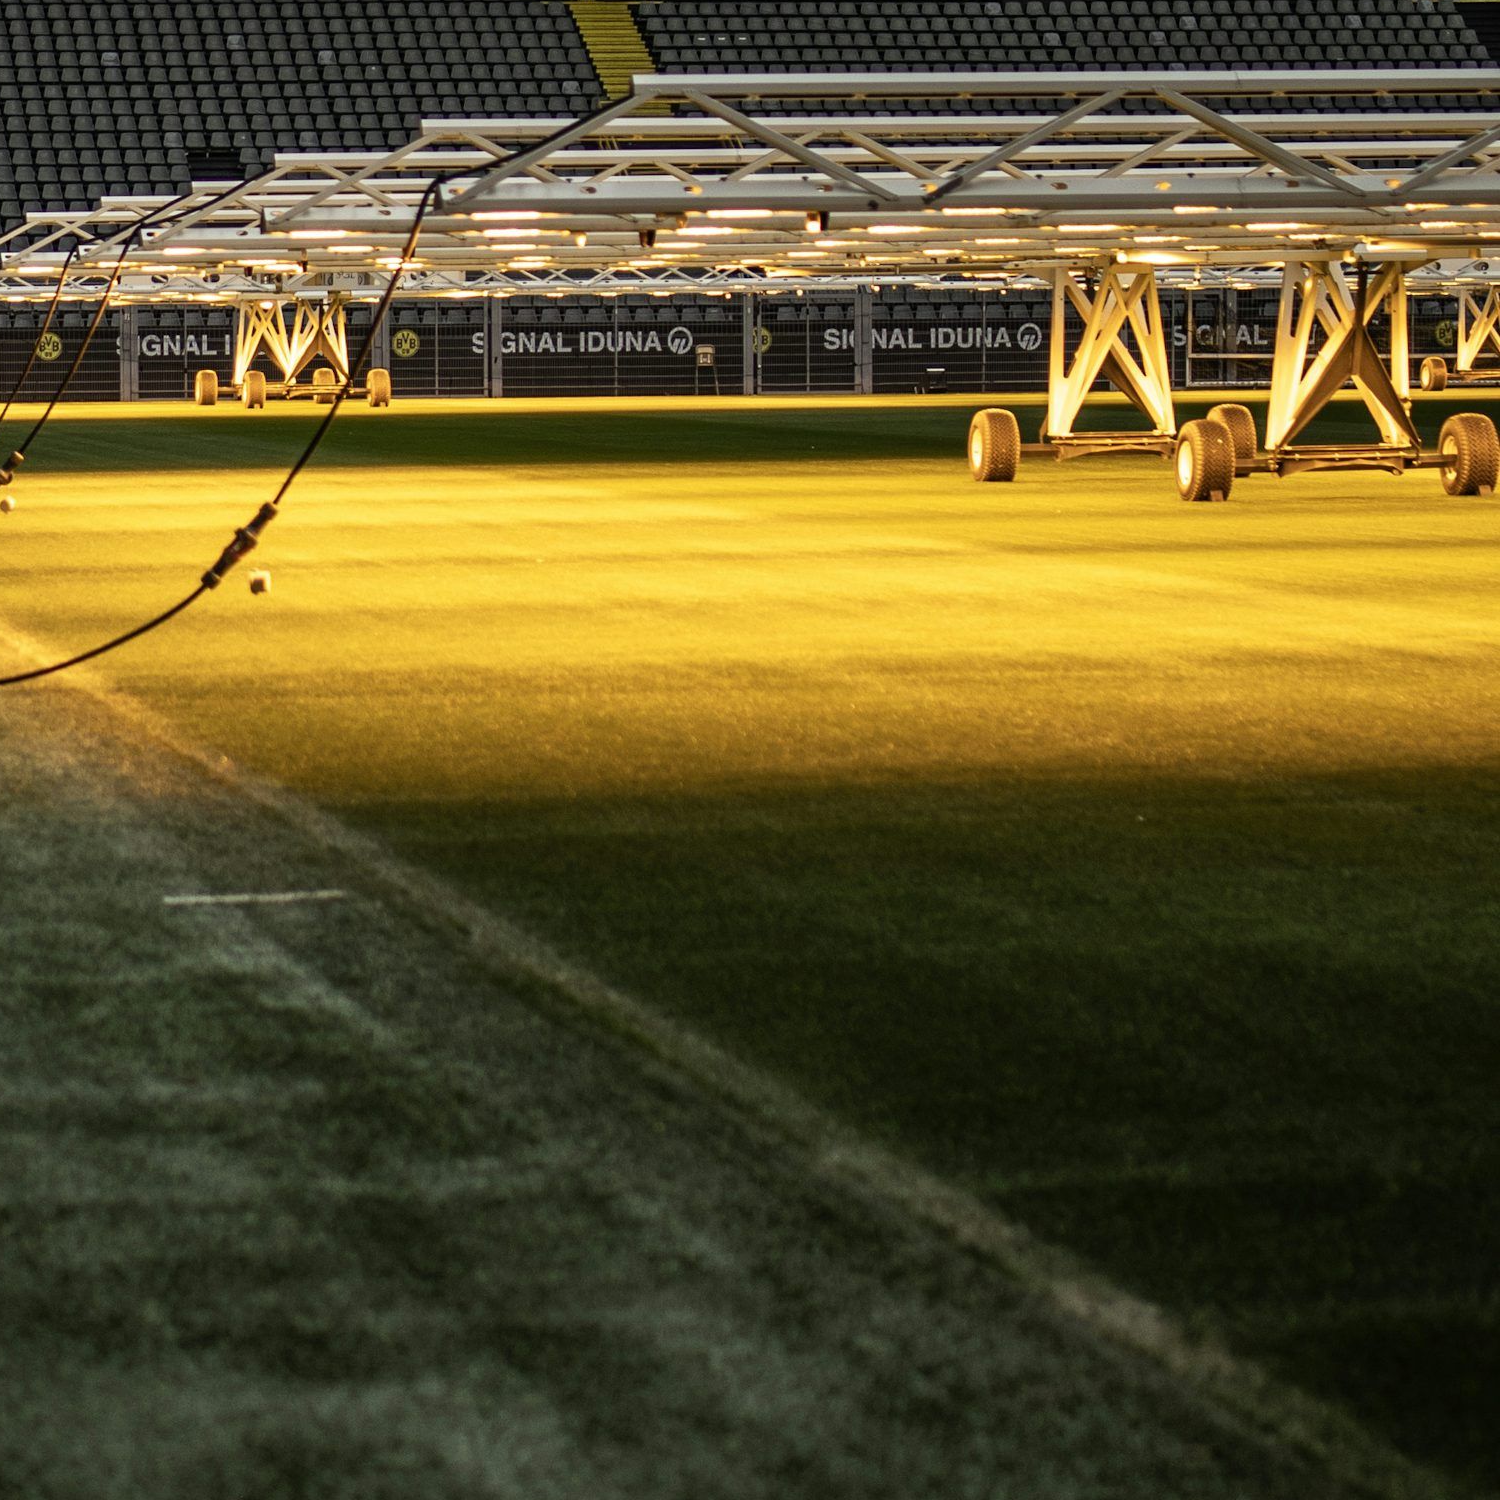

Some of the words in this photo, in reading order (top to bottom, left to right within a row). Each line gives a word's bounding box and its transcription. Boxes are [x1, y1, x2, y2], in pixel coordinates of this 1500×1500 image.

[39, 336, 59, 351] BVB
[116, 334, 218, 356] GNAL
[396, 329, 416, 349] BVB
[471, 331, 572, 354] SGNAL
[580, 331, 662, 353] IDUNA
[930, 327, 1012, 349] IDUNA
[1173, 324, 1269, 347] SGAL
